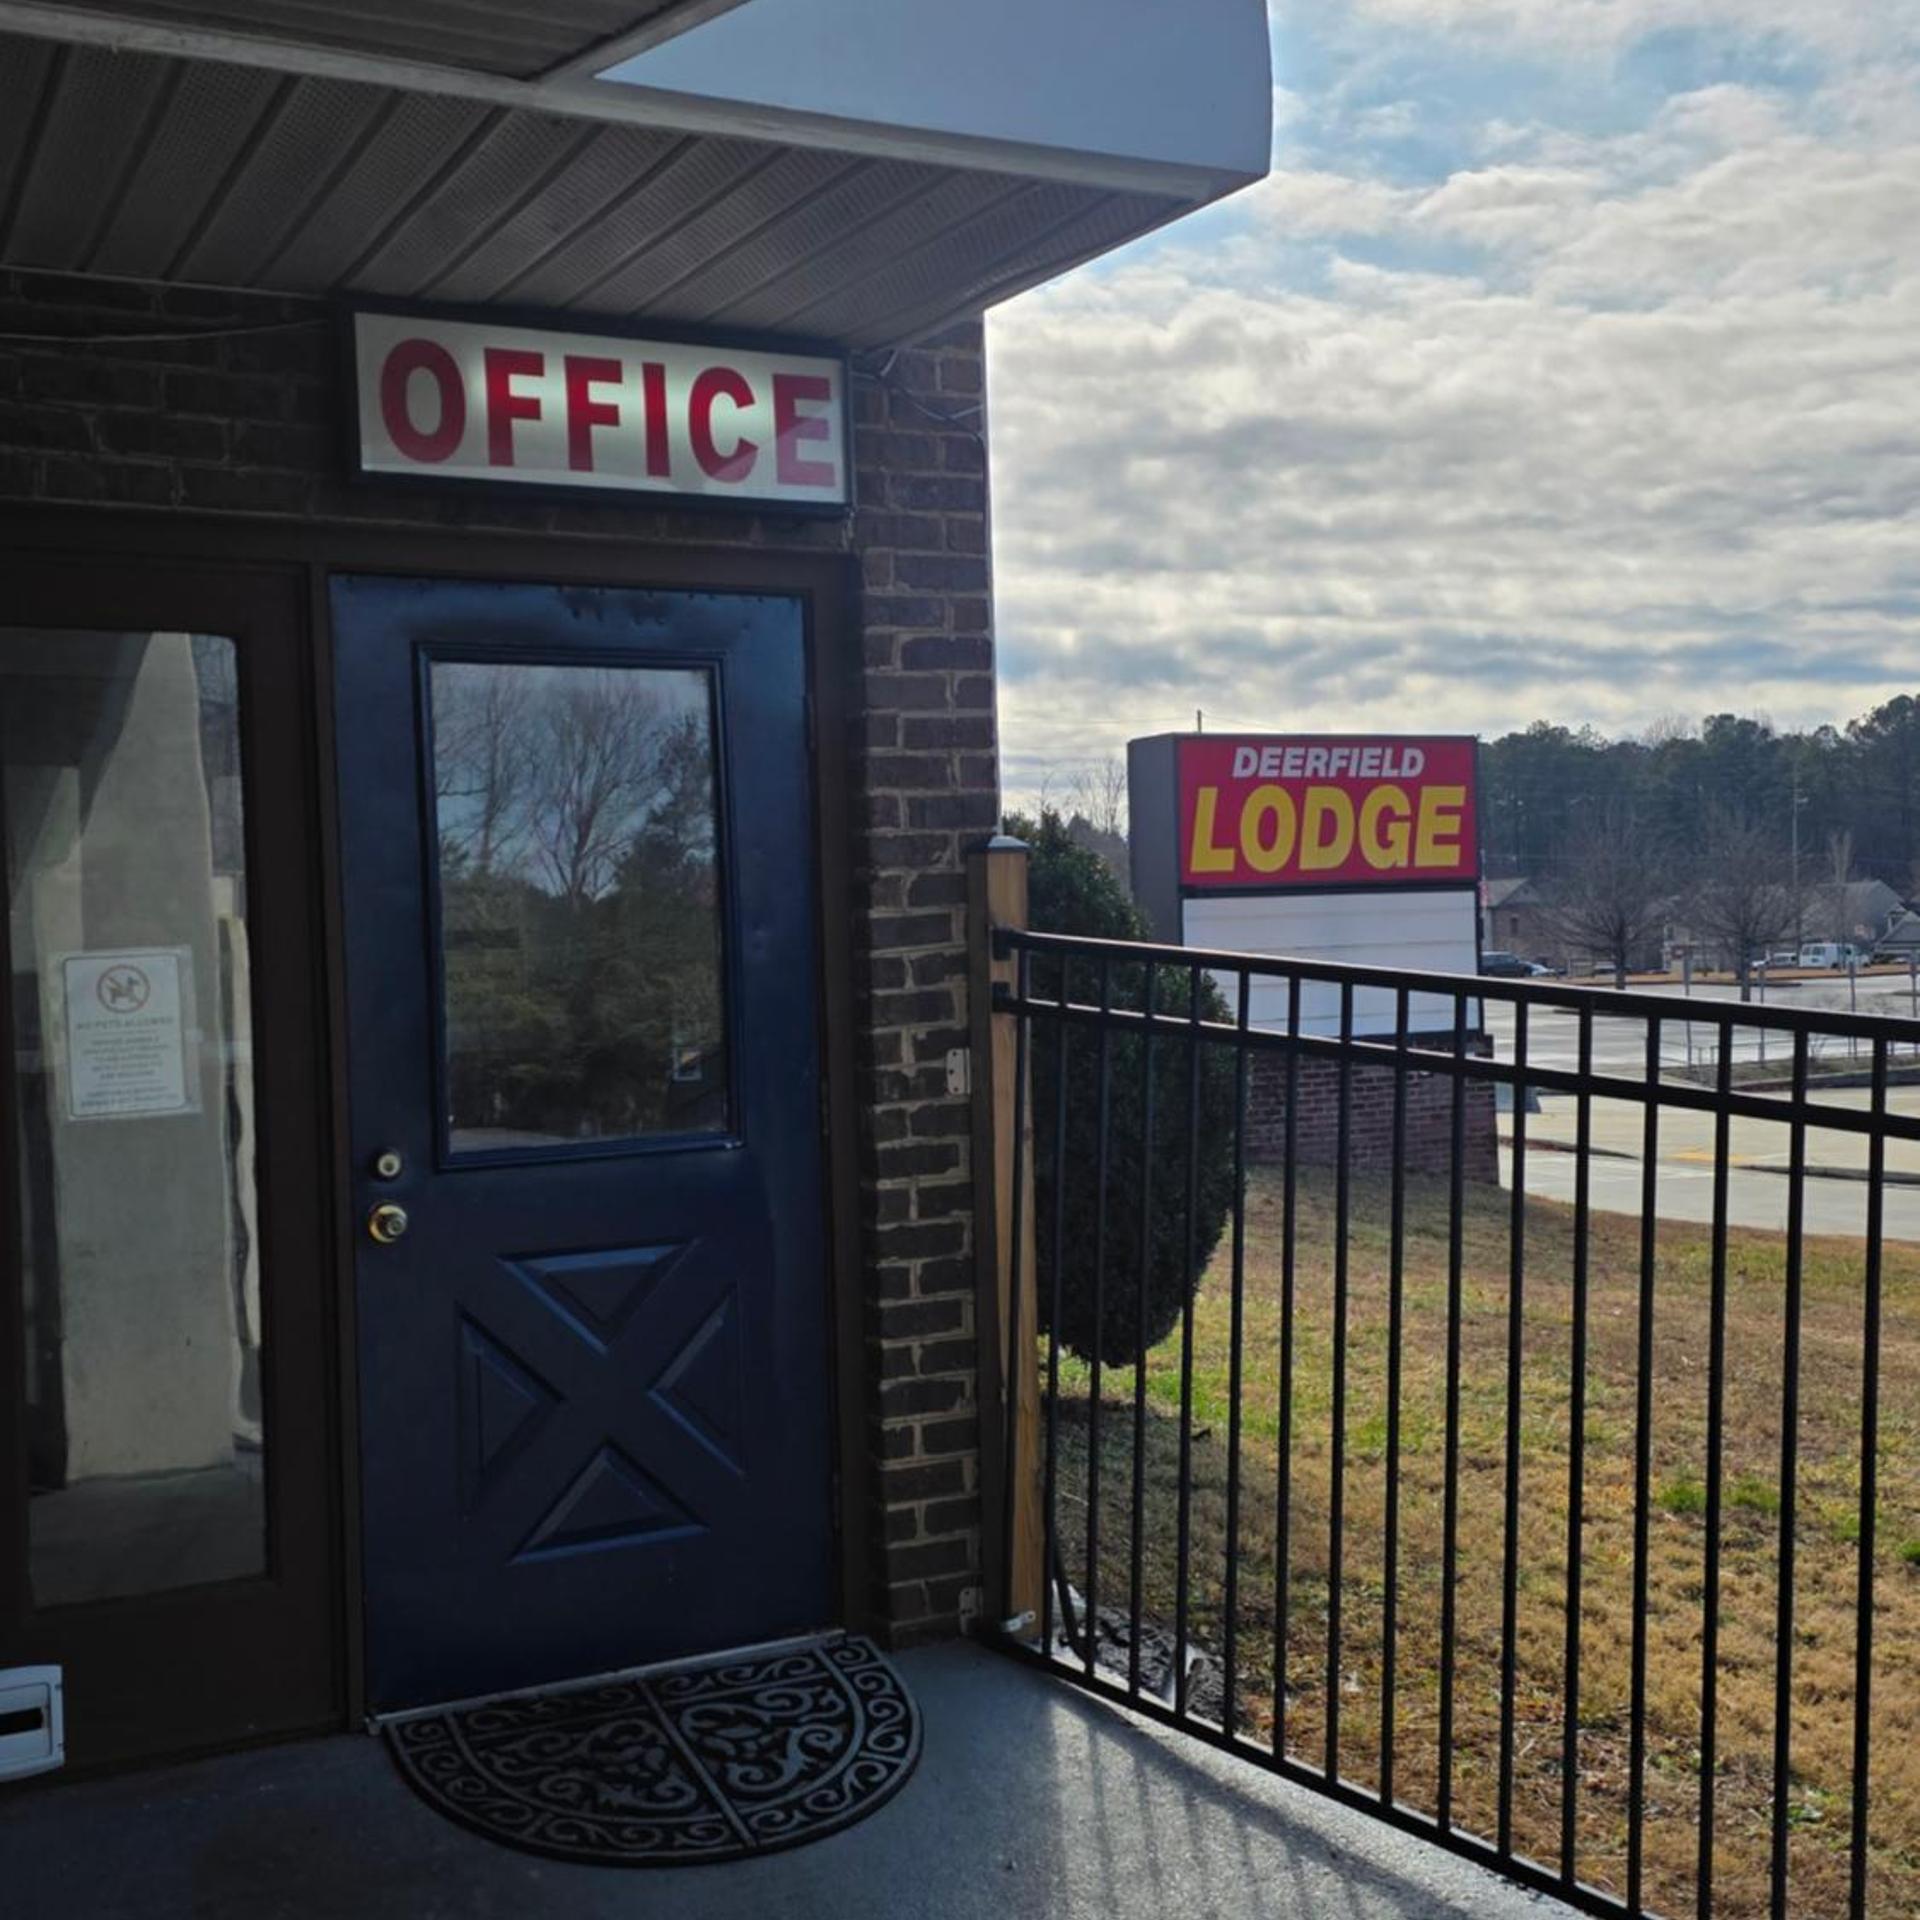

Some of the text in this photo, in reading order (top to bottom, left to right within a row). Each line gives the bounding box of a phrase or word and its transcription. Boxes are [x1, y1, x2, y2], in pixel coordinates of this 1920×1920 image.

[380, 338, 836, 486] OFFICE
[1232, 747, 1425, 778] DEERFIELD
[1190, 785, 1466, 873] LODGE
